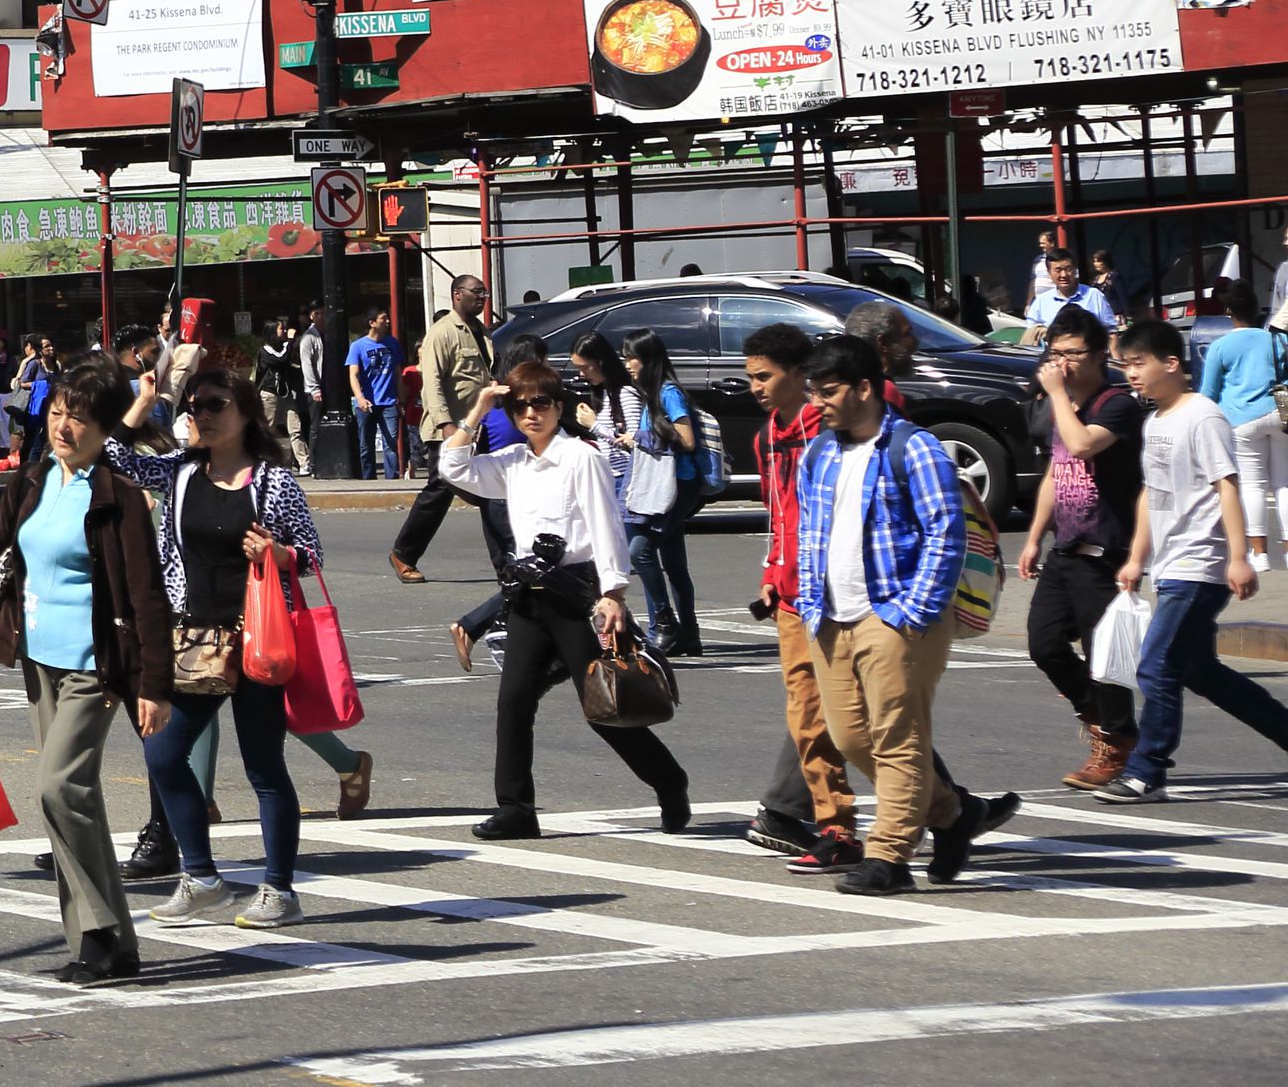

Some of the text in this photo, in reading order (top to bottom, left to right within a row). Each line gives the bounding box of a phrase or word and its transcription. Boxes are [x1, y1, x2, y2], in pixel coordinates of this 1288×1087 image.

[128, 3, 223, 20] 41-25 Kissena Blvd.
[339, 13, 427, 35] KISSENA BLVD
[712, 24, 745, 41] Lunch
[756, 22, 785, 39] $7.99
[117, 38, 239, 55] THE PARK REGENT CONDOMINIUM
[861, 21, 1153, 60] 41-01 KISSENA BLVD FLUSHING NY 11355
[281, 45, 306, 64] MAIN
[796, 52, 822, 64] Hours
[856, 48, 1172, 93] 718-321-1212 718-321-1175
[779, 89, 837, 101] 41-19 Kissena
[779, 101, 800, 112] (718)
[306, 139, 367, 153] ONE WAY
